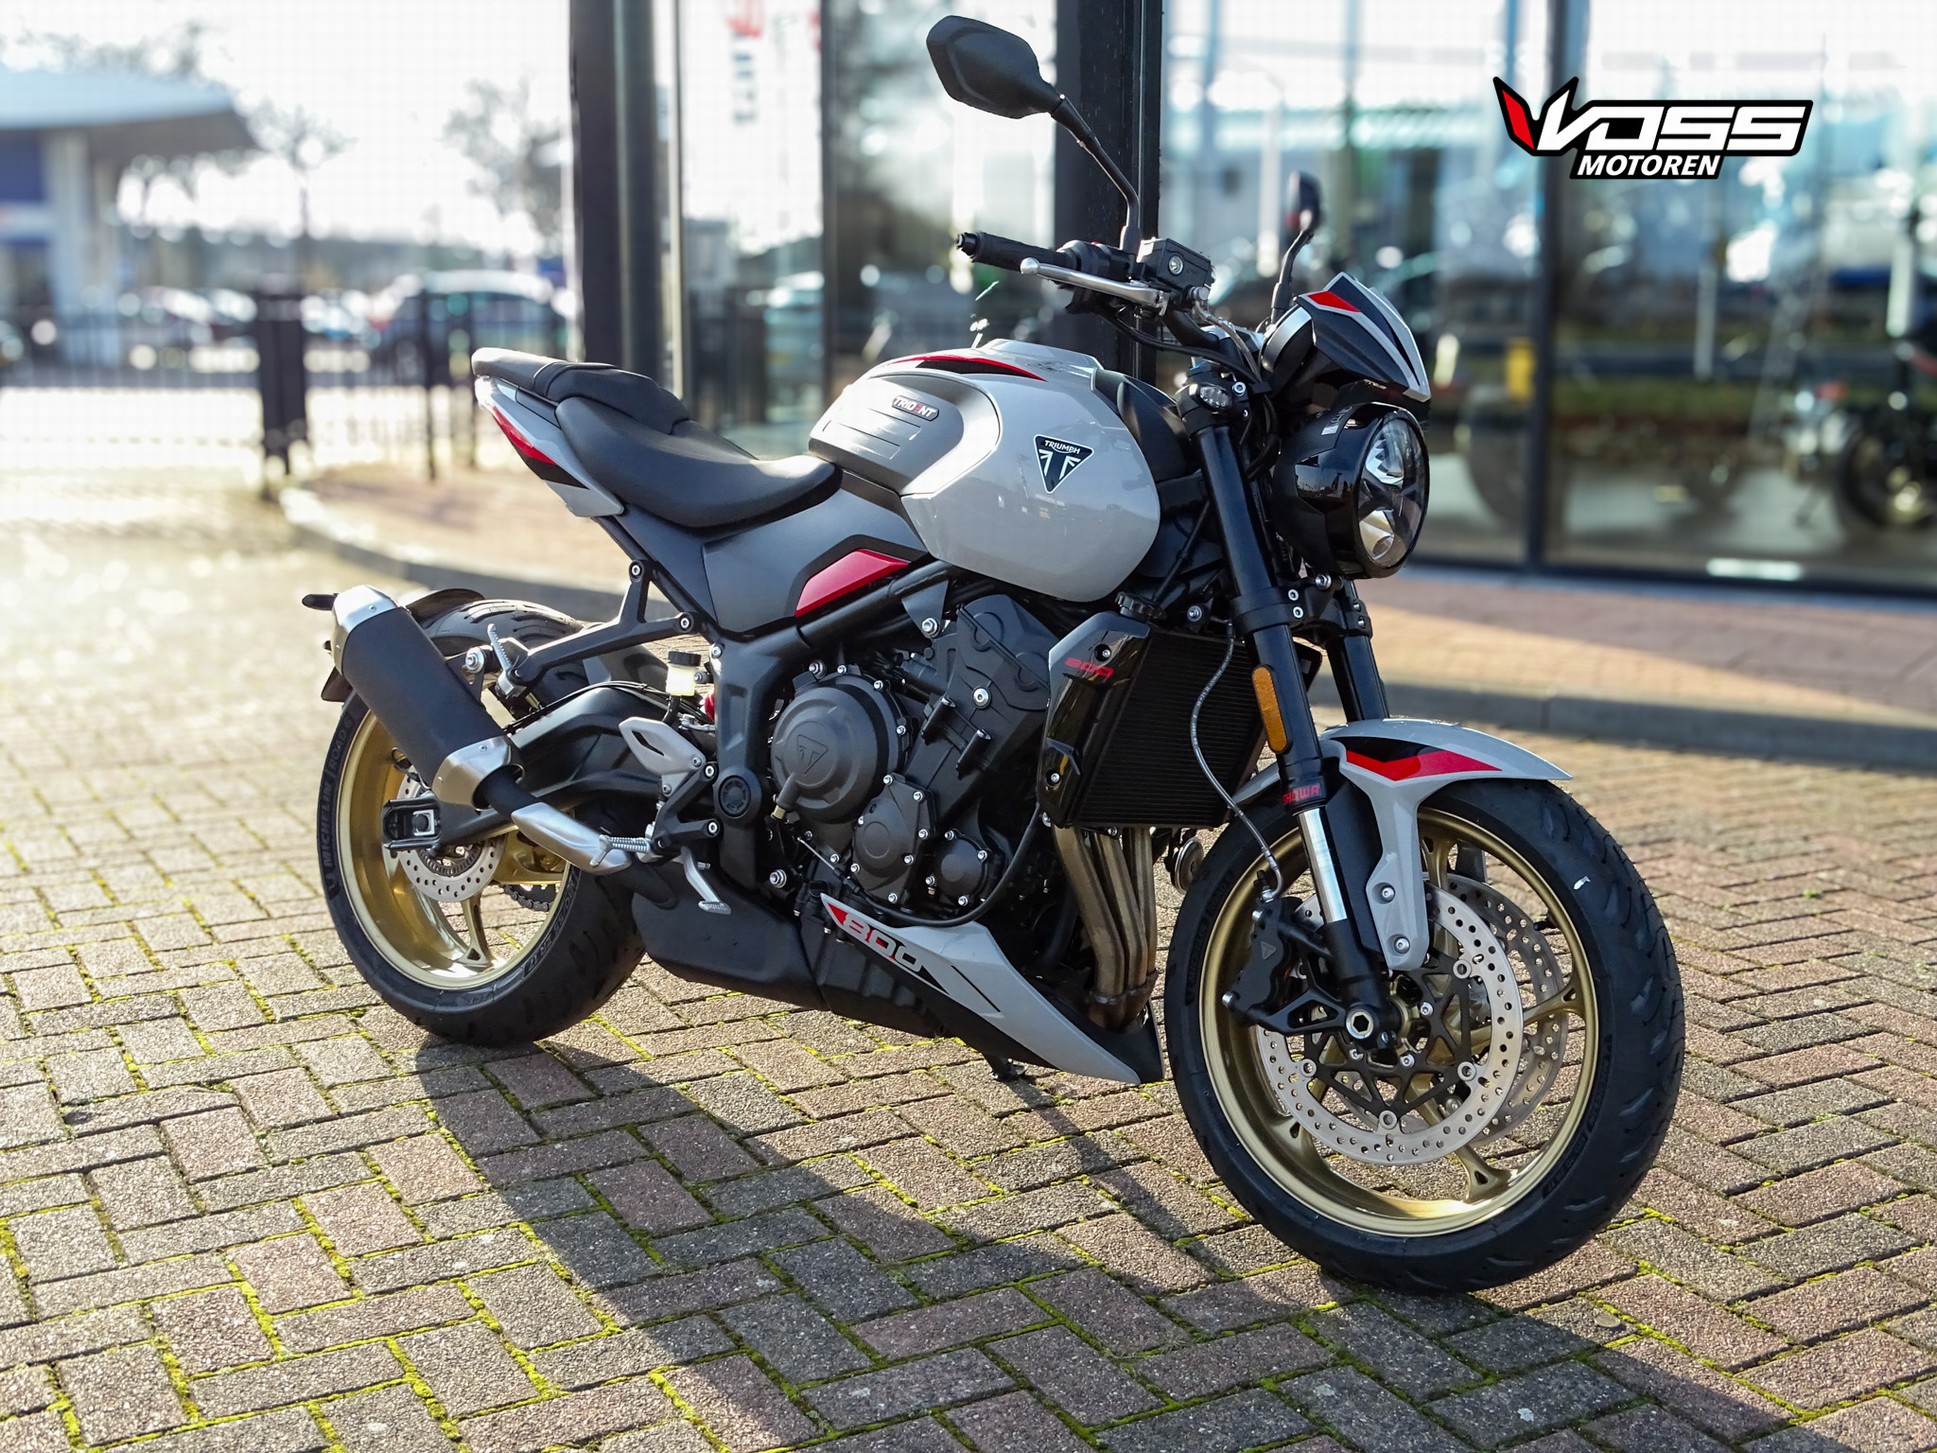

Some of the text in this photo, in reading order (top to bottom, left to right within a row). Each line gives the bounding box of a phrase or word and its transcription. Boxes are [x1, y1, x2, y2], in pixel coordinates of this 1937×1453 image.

[893, 398, 937, 418] TRIDENT
[1044, 440, 1081, 455] TRIUMPH
[320, 783, 334, 868] MICHELIN
[328, 729, 348, 769] ROAD
[842, 912, 924, 973] 800
